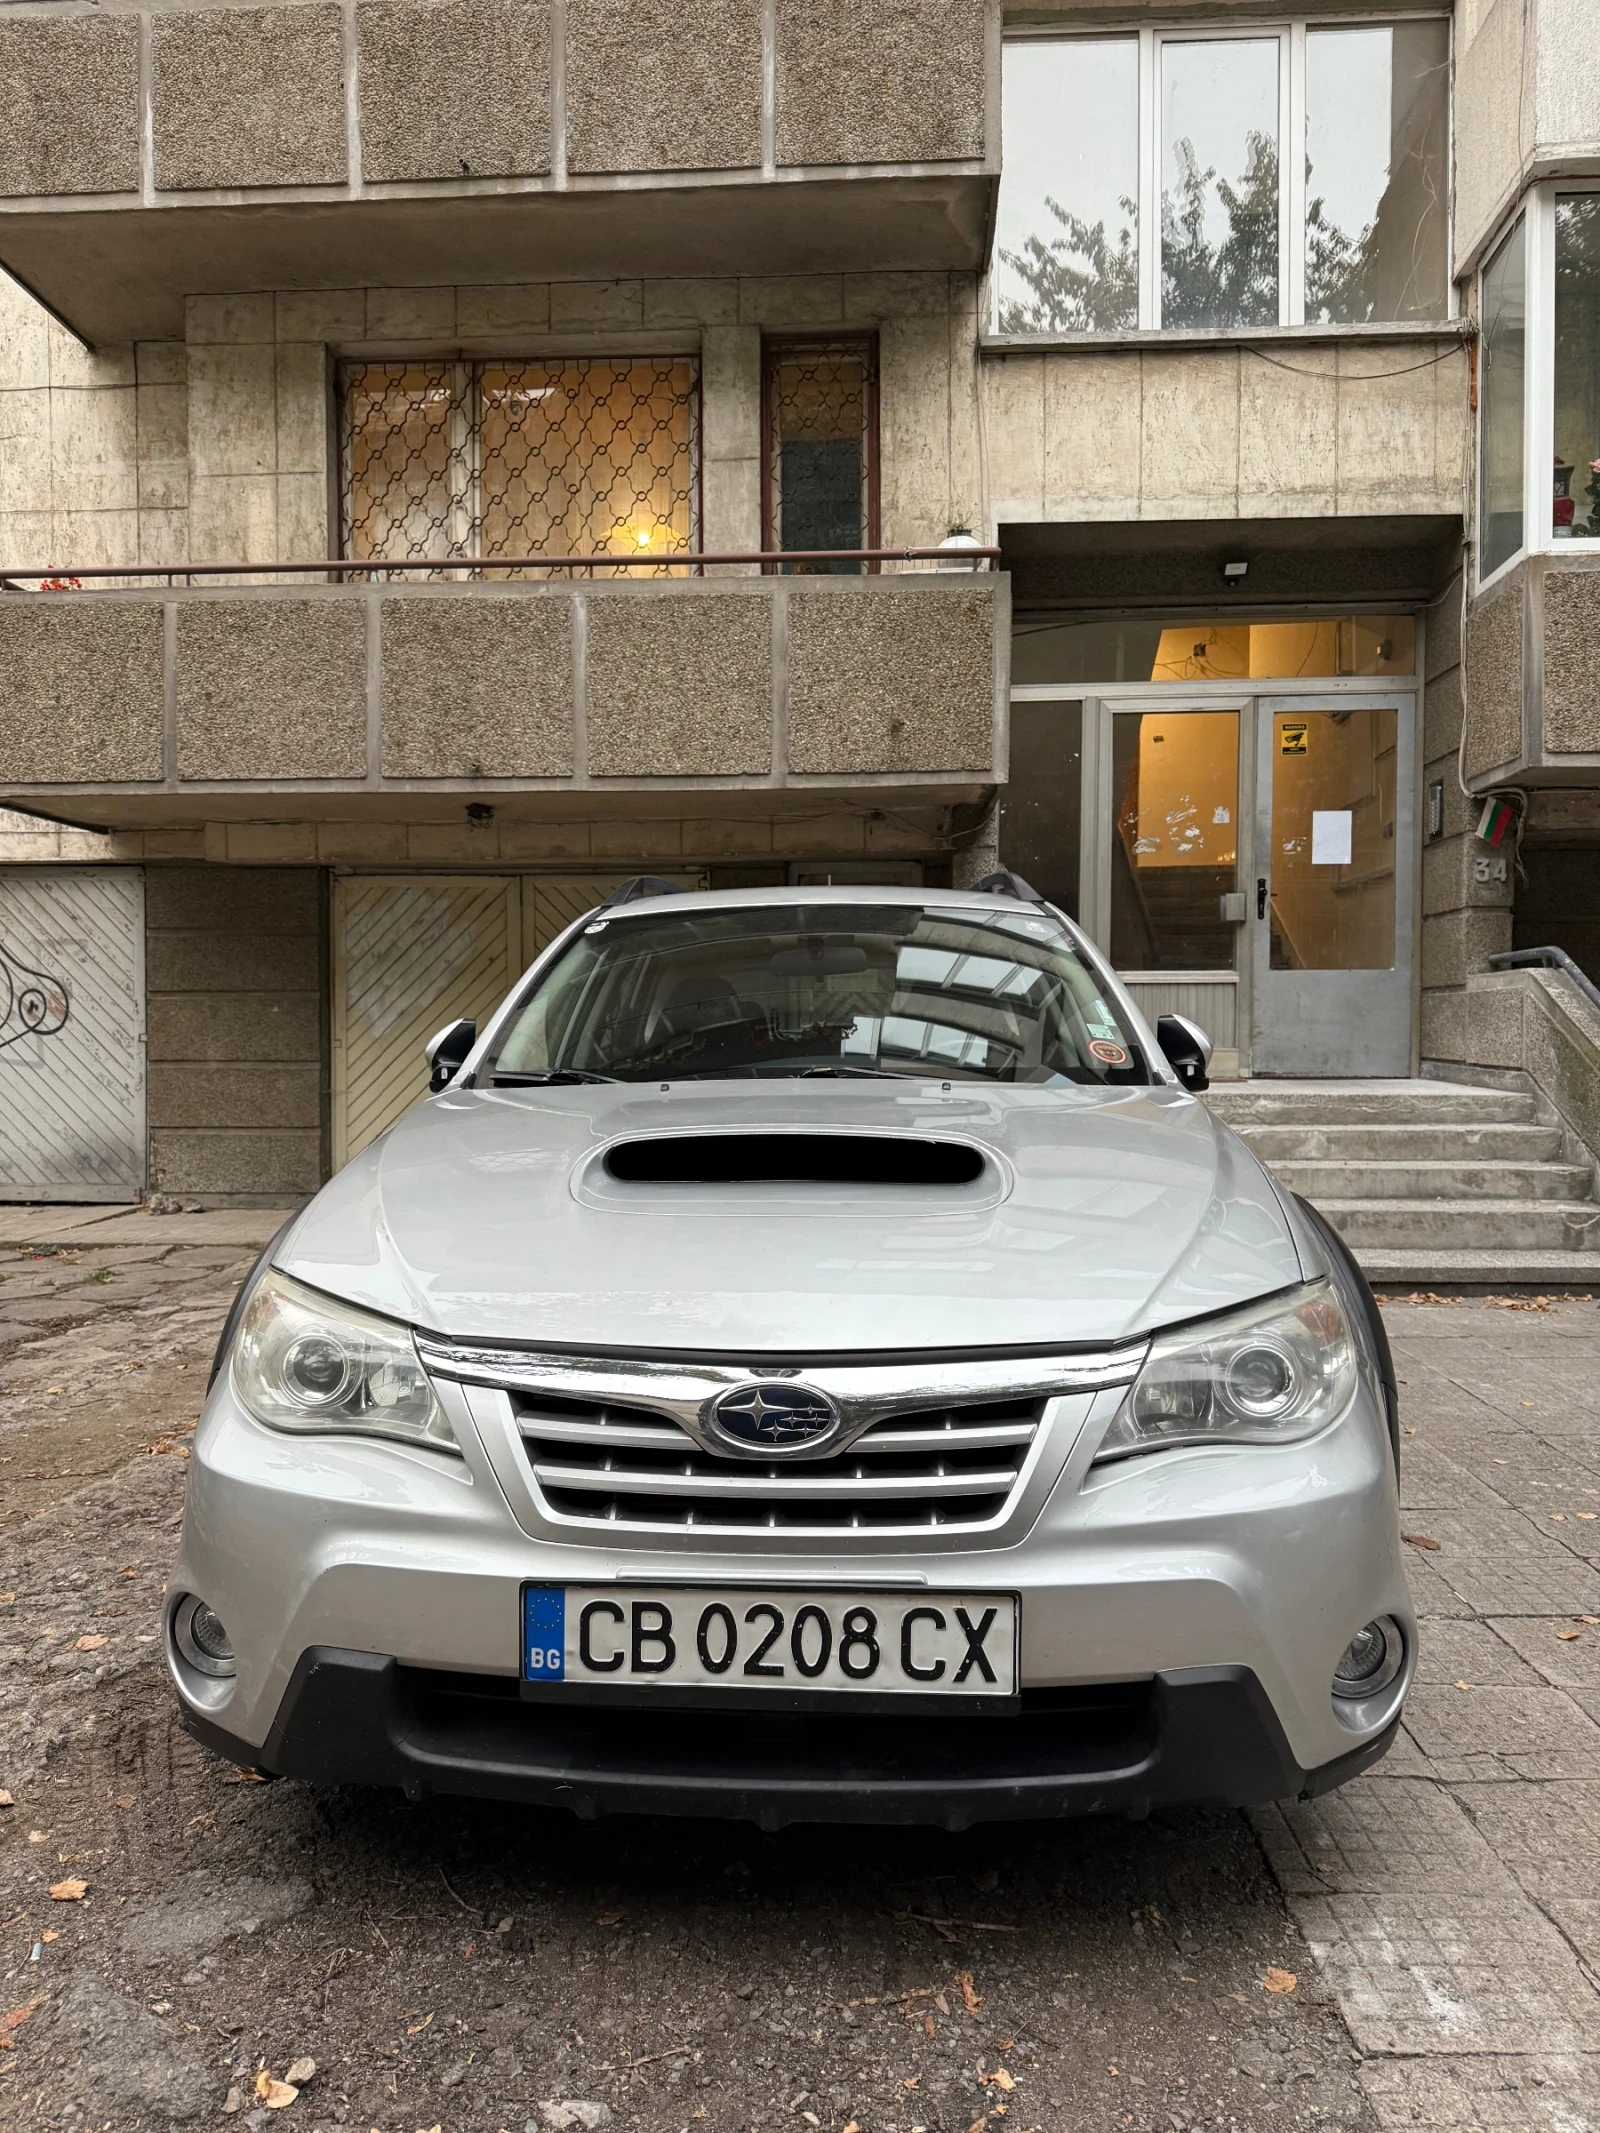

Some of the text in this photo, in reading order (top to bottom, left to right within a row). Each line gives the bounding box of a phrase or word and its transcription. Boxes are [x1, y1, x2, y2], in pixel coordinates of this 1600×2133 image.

[1475, 857, 1507, 882] 34
[579, 1600, 998, 1683] CB 0208 CX
[531, 1647, 560, 1669] BG
